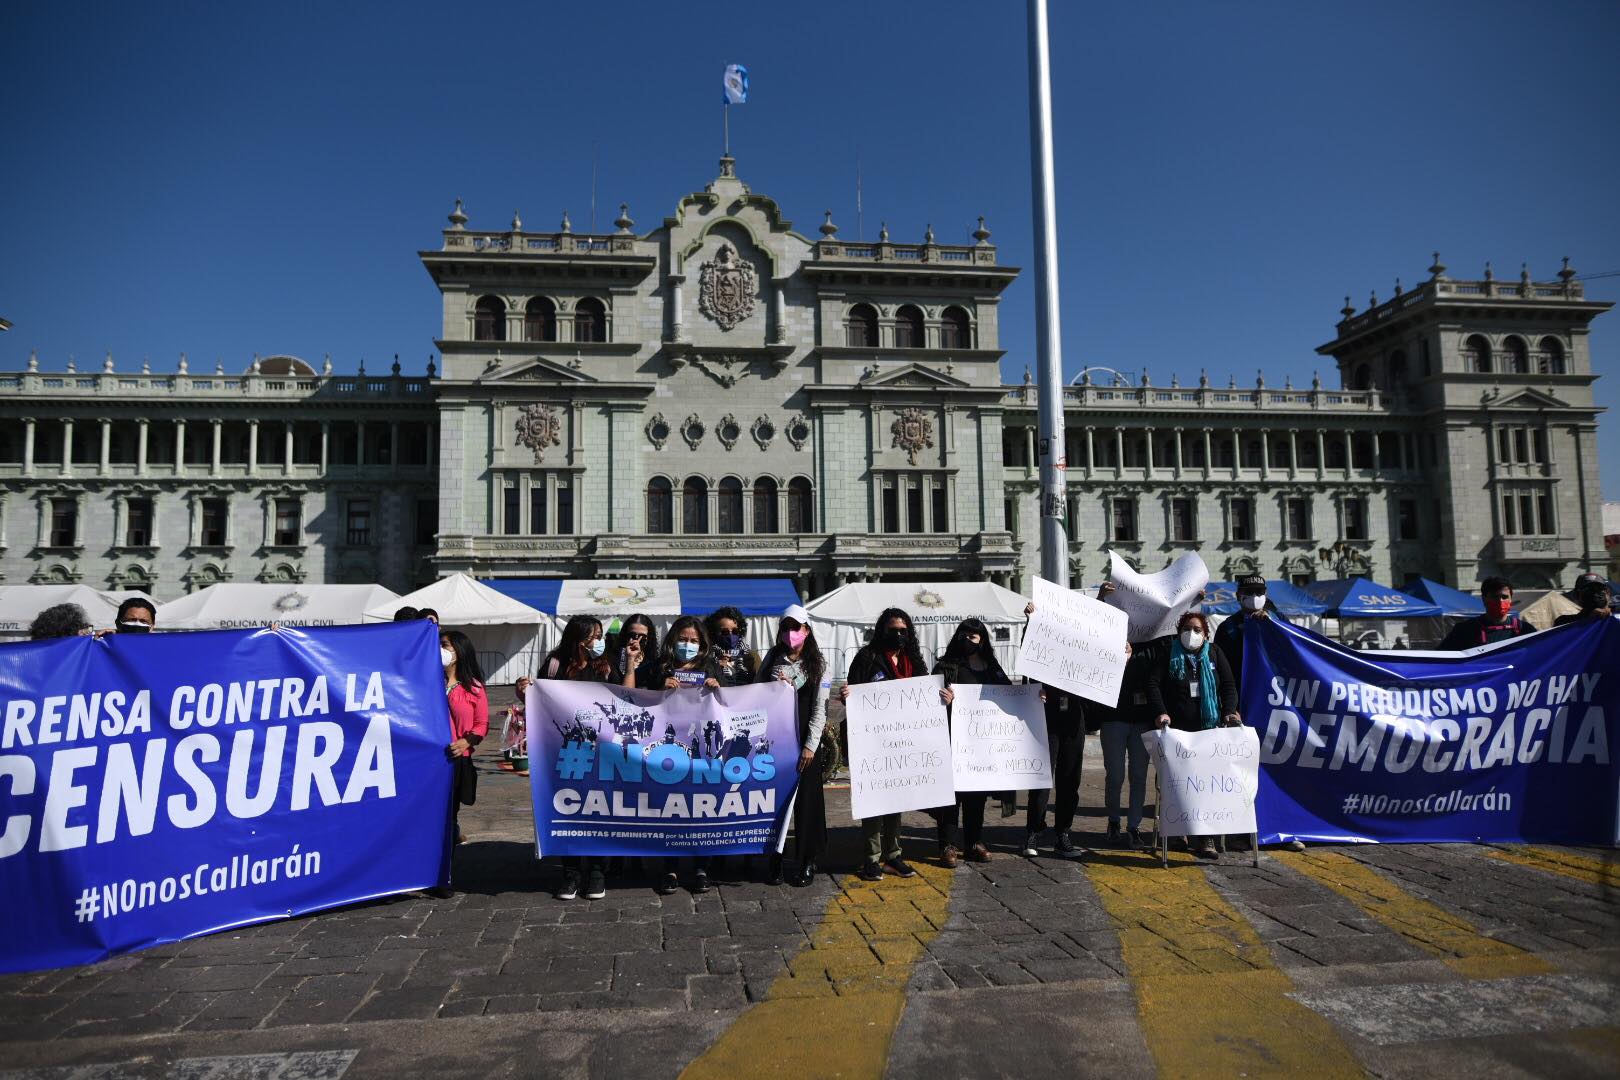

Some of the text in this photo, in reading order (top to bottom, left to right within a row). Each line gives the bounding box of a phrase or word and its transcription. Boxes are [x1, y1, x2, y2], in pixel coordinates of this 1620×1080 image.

[220, 619, 258, 628] POLICIA
[261, 619, 307, 628] NACIONAL
[922, 614, 963, 623] NACIONAL
[967, 614, 988, 622] CIVIL
[862, 691, 891, 711] NO
[1267, 672, 1603, 717] SIN PERIODISMO NO HAY
[0, 671, 386, 749] RENSA CONTRA LA
[1175, 741, 1197, 760] las
[1258, 705, 1611, 774] DEMOCRACIA
[1005, 759, 1043, 772] MIEDO
[0, 714, 397, 859] CENSURA
[552, 783, 776, 818] CALLARÁN
[1342, 785, 1511, 816] #NOnosCallarán
[551, 830, 609, 838] PERIODISTAS
[611, 831, 664, 839] FEMINISTAS
[735, 828, 776, 837] EXPRESIÓN
[748, 836, 777, 844] GÉNERO
[75, 844, 321, 923] #NOnosCallarán
